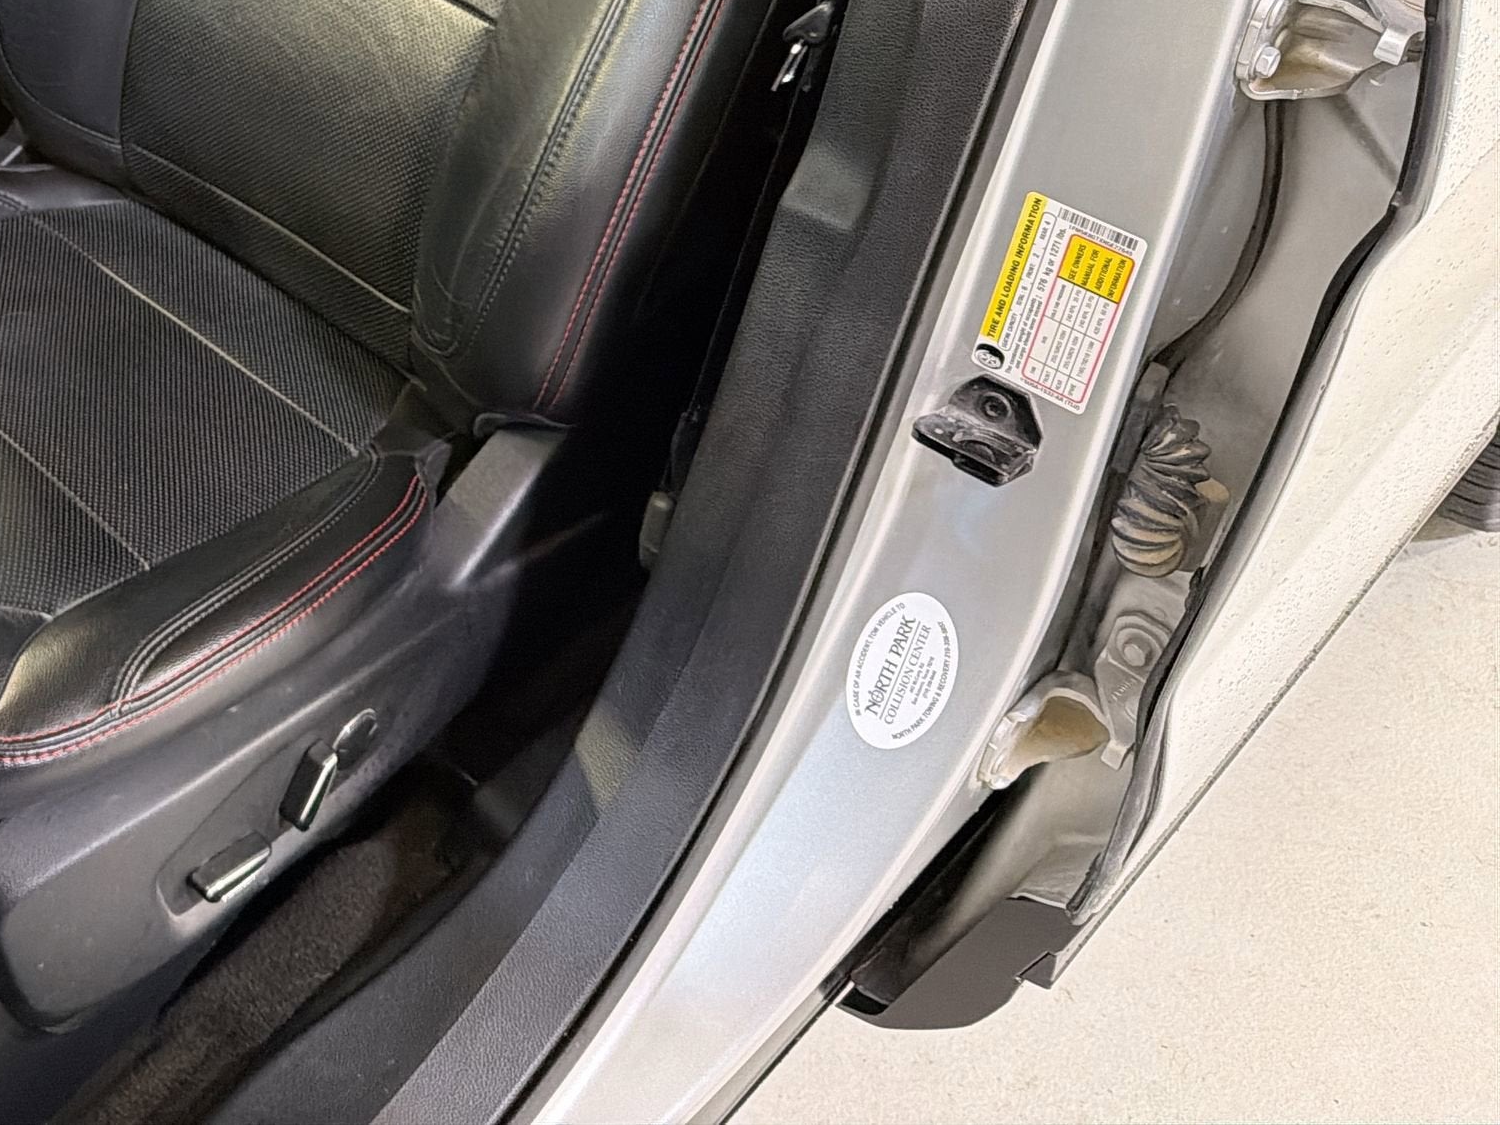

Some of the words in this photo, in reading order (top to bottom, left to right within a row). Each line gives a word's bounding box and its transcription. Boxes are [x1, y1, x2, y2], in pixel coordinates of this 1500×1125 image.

[1049, 240, 1061, 256] 1271
[1055, 228, 1066, 239] lbs.
[986, 317, 999, 337] TIRE
[994, 298, 1006, 317] AND
[1000, 259, 1020, 298] LOADING
[1014, 197, 1042, 258] INFORMATION
[1042, 266, 1053, 276] kg
[1047, 258, 1054, 266] or
[1067, 268, 1077, 280] SEE
[1072, 243, 1086, 268] OWNERS
[1080, 263, 1095, 286] MANUAL
[1089, 248, 1099, 261] FOR
[1094, 257, 1112, 291] ADDITIONAL
[1106, 258, 1126, 298] INFORMATION
[1036, 277, 1047, 292] 576
[868, 626, 879, 639] TOW
[877, 606, 897, 627] VEHICLE
[896, 602, 906, 612] TO
[865, 658, 898, 716] NORTH
[888, 614, 916, 658] PARK
[884, 667, 915, 725] COLLISION
[909, 624, 932, 667] CENTER
[892, 728, 911, 739] NORTH
[910, 717, 925, 731] PARK
[922, 698, 939, 718] TOWING
[937, 659, 950, 692] RECOVERY
